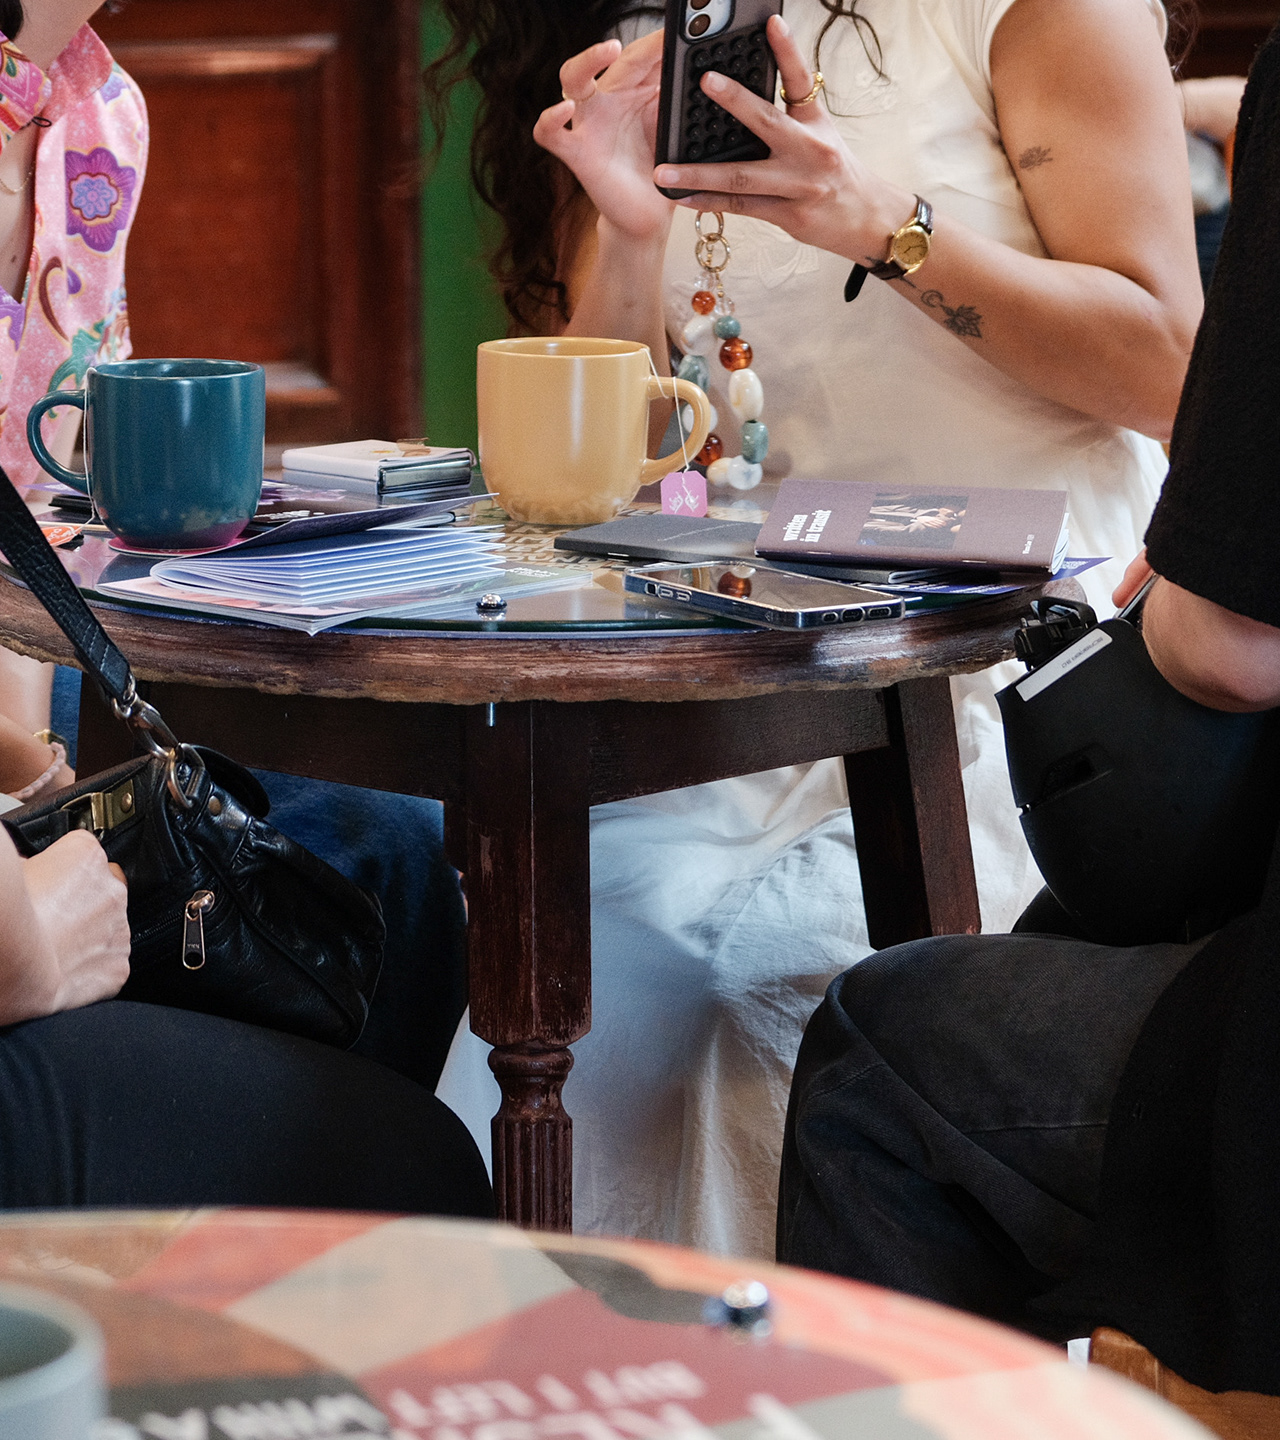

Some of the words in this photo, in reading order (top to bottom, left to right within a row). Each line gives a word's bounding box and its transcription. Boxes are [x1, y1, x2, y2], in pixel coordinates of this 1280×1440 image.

[782, 514, 809, 542] written
[805, 509, 832, 533] transit
[800, 533, 821, 543] in
